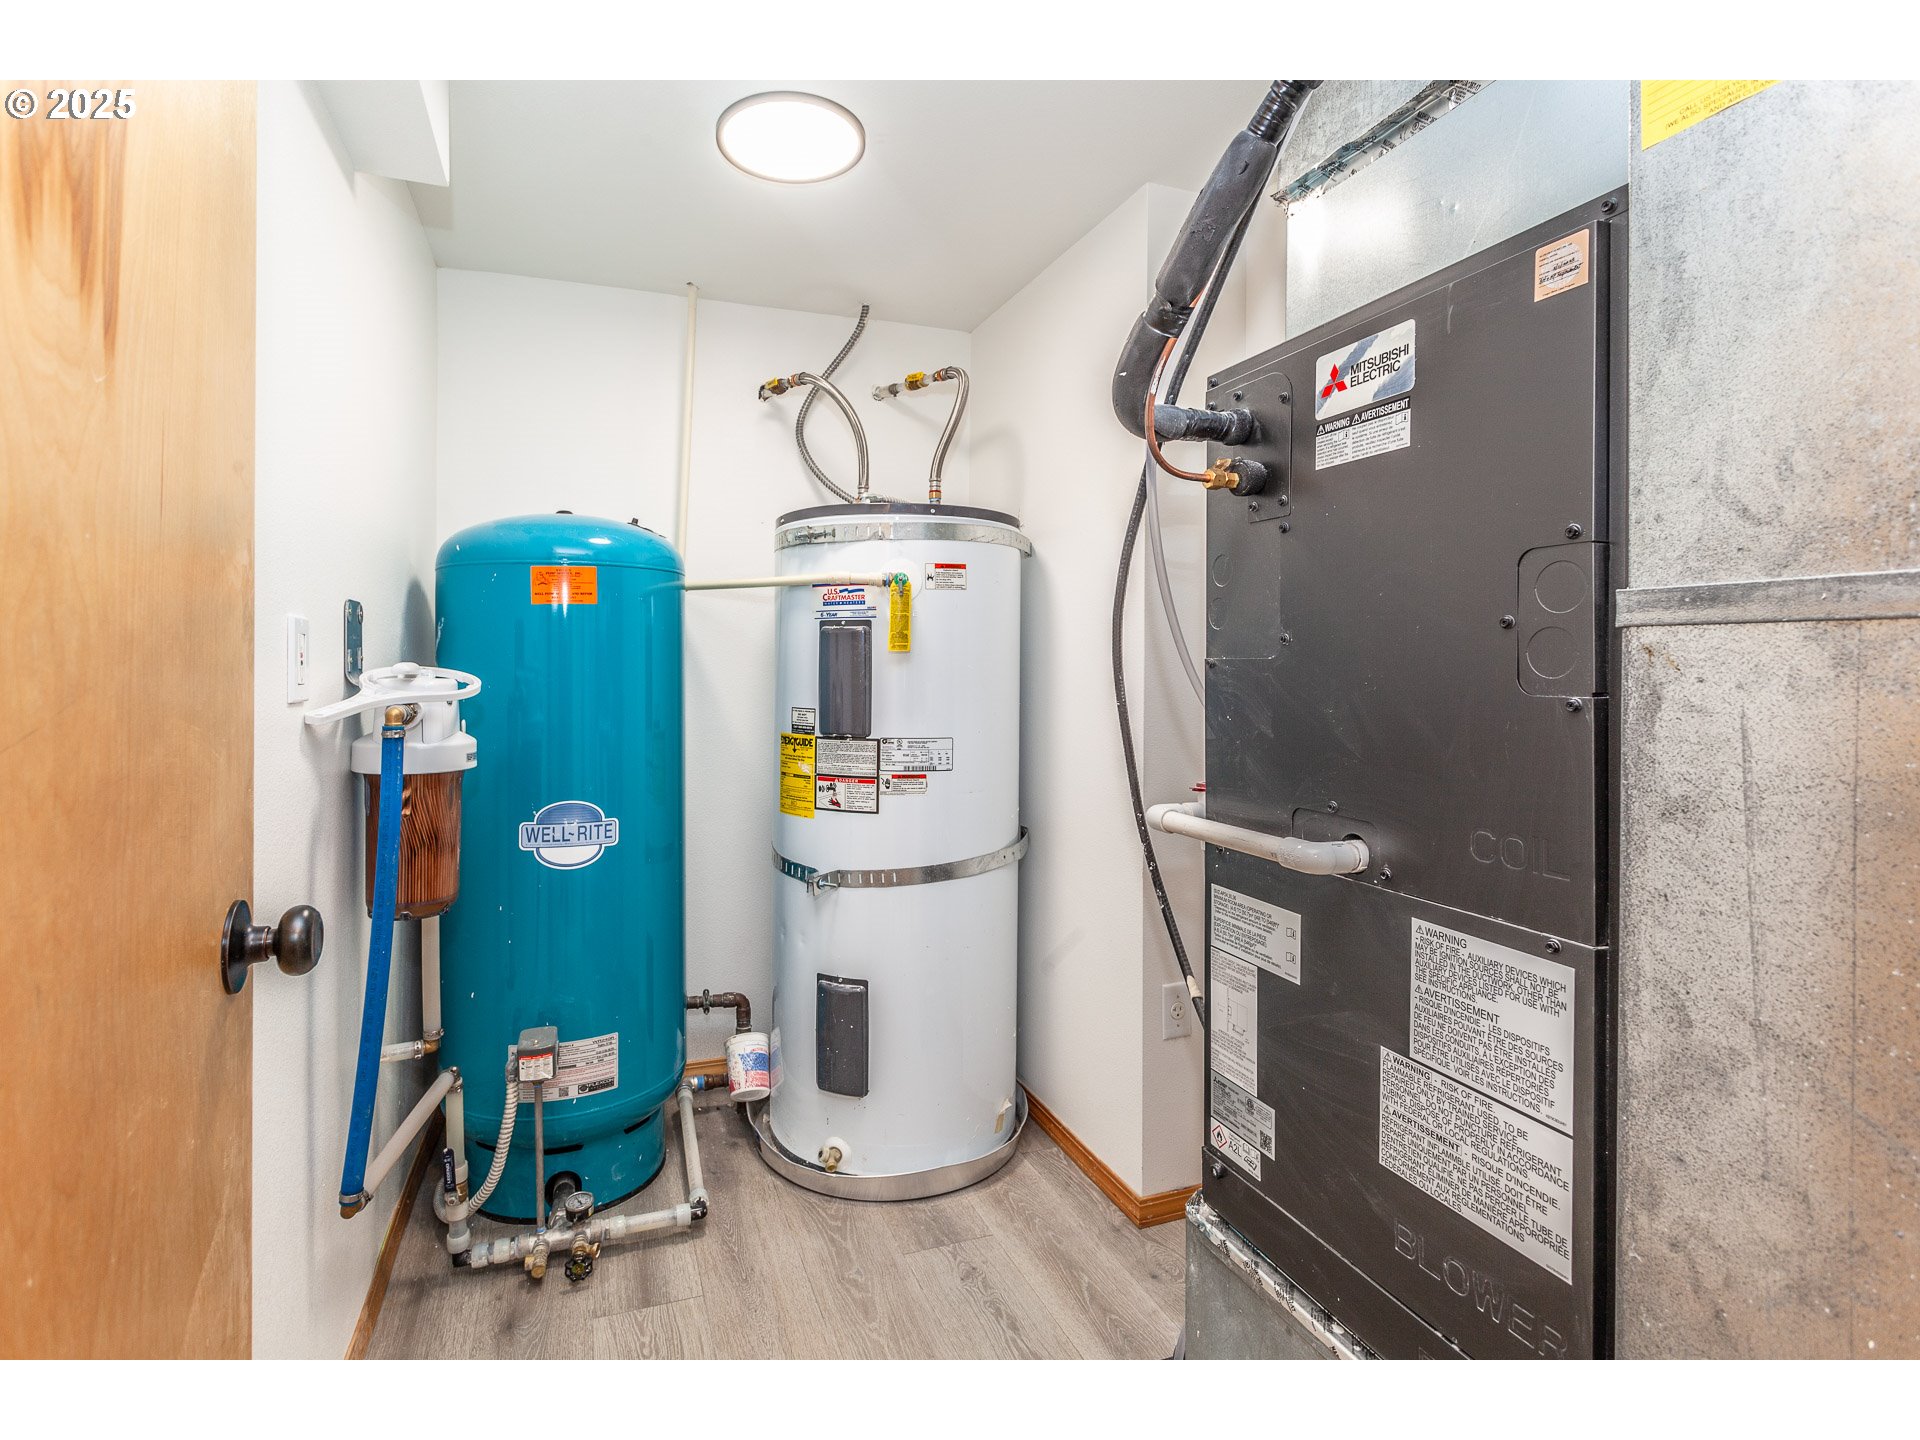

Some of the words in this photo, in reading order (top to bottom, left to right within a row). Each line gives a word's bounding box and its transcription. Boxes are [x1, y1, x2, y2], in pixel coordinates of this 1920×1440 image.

[1350, 343, 1410, 375] MITSUBISHI
[1350, 360, 1401, 388] ELECTRIC
[1325, 417, 1350, 432] WARNING
[1360, 398, 1410, 421] AVERTISSEMENT
[1470, 828, 1570, 881] COIL
[1419, 935, 1434, 947] RISK
[1435, 940, 1444, 950] OF
[1445, 944, 1460, 956] FIRE
[1467, 951, 1503, 971] AUXILIARY
[1505, 964, 1537, 983] DEVICES
[1539, 975, 1566, 993] WHICH
[1424, 926, 1466, 949] WARNING
[1414, 964, 1426, 976] THE
[1428, 969, 1457, 988] SPECIFIC
[1458, 980, 1497, 1003] APPLIANCE.
[1414, 972, 1426, 984] SEE
[1428, 977, 1477, 1004] INSTRUCTIONS.
[1415, 941, 1428, 953] MAY
[1429, 946, 1437, 956] BE
[1439, 950, 1467, 967] IGNITION
[1469, 960, 1502, 979] SOURCES
[1504, 972, 1527, 988] SHALL
[1530, 981, 1546, 995] NOT
[1548, 987, 1558, 999] BE
[1415, 949, 1447, 968] INSTALLED
[1449, 961, 1455, 971] IN
[1457, 964, 1470, 976] THE
[1516, 985, 1543, 1003] OTHER
[1545, 995, 1566, 1011] THAN
[1415, 956, 1447, 976] AUXILIARY
[1448, 969, 1477, 987] DEVICES
[1478, 980, 1502, 996] LISTED
[1504, 989, 1520, 1003] FOR
[1522, 996, 1537, 1010] USE
[1539, 1002, 1559, 1018] WITH
[1414, 1010, 1422, 1021] DE
[1423, 1014, 1435, 1027] FEU
[1437, 1020, 1445, 1031] NE
[1447, 1024, 1477, 1045] DOIVENT
[1478, 1038, 1492, 1052] PAS
[1418, 994, 1442, 1011] RISQUE
[1488, 1023, 1501, 1036] LES
[1503, 1029, 1550, 1057] DISPOSITIFS
[1424, 986, 1499, 1026] AVERTISSEMENT
[1413, 1027, 1451, 1052] DISPOSITIFS
[1452, 1045, 1494, 1072] AUXILIAIRES
[1413, 1018, 1430, 1033] DANS
[1431, 1026, 1443, 1040] LES
[1538, 1074, 1554, 1090] DES
[1414, 1002, 1452, 1025] AUXILIAIRES
[1453, 1018, 1485, 1040] POUVANT
[1508, 1041, 1523, 1056] DES
[1524, 1048, 1563, 1074] SOURCES
[1382, 1059, 1421, 1086] FLAMMABLE
[1423, 1080, 1475, 1114] REFRIGERANT
[1503, 1120, 1514, 1134] TO
[1516, 1126, 1528, 1141] BE
[1392, 1055, 1430, 1081] WARNING
[1440, 1078, 1458, 1095] RISK
[1460, 1088, 1471, 1101] OF
[1474, 1095, 1495, 1113] FIRE.
[1413, 1036, 1430, 1052] POUR
[1481, 1068, 1500, 1085] AVEC
[1502, 1077, 1510, 1090] LE
[1512, 1082, 1554, 1111] DISPOSITIF
[1453, 1064, 1469, 1080] VOIR
[1471, 1072, 1484, 1087] LES
[1382, 1067, 1414, 1091] REPAIRED
[1416, 1085, 1434, 1101] ONLY
[1436, 1095, 1446, 1107] BY
[1448, 1101, 1480, 1125] TRAINED
[1482, 1118, 1517, 1145] SERVICE
[1382, 1091, 1398, 1108] WITH
[1399, 1101, 1430, 1126] FEDERAL
[1432, 1118, 1442, 1132] OR
[1444, 1125, 1468, 1146] LOCAL
[1228, 1140, 1242, 1158] A2L
[1392, 1108, 1460, 1153] AVERTISSEMENT
[1471, 1152, 1503, 1178] RISQUE
[1409, 1098, 1439, 1122] DISPOSE
[1441, 1115, 1452, 1128] OF
[1454, 1121, 1495, 1152] PROPERLY
[1497, 1144, 1504, 1157] IN
[1506, 1149, 1569, 1192] ACCORDANCE
[1425, 1098, 1436, 1111] DO
[1438, 1104, 1453, 1120] NOT
[1455, 1113, 1497, 1143] PUNCTURE
[1500, 1136, 1561, 1177] REFRIGERANT
[1407, 1136, 1451, 1169] UNIQUEMENT
[1452, 1163, 1466, 1178] PAR
[1468, 1172, 1478, 1185] UN
[1480, 1179, 1528, 1215] PERSONNEL
[1418, 1178, 1428, 1192] OU
[1436, 1180, 1450, 1196] AUX
[1461, 1186, 1471, 1200] DE
[1504, 1183, 1523, 1202] DOIT
[1457, 1175, 1466, 1188] NE
[1468, 1181, 1483, 1198] PAS
[1485, 1191, 1516, 1218] PERCER
[1519, 1211, 1528, 1225] LE
[1531, 1218, 1553, 1240] TUBE
[1555, 1232, 1567, 1248] DE
